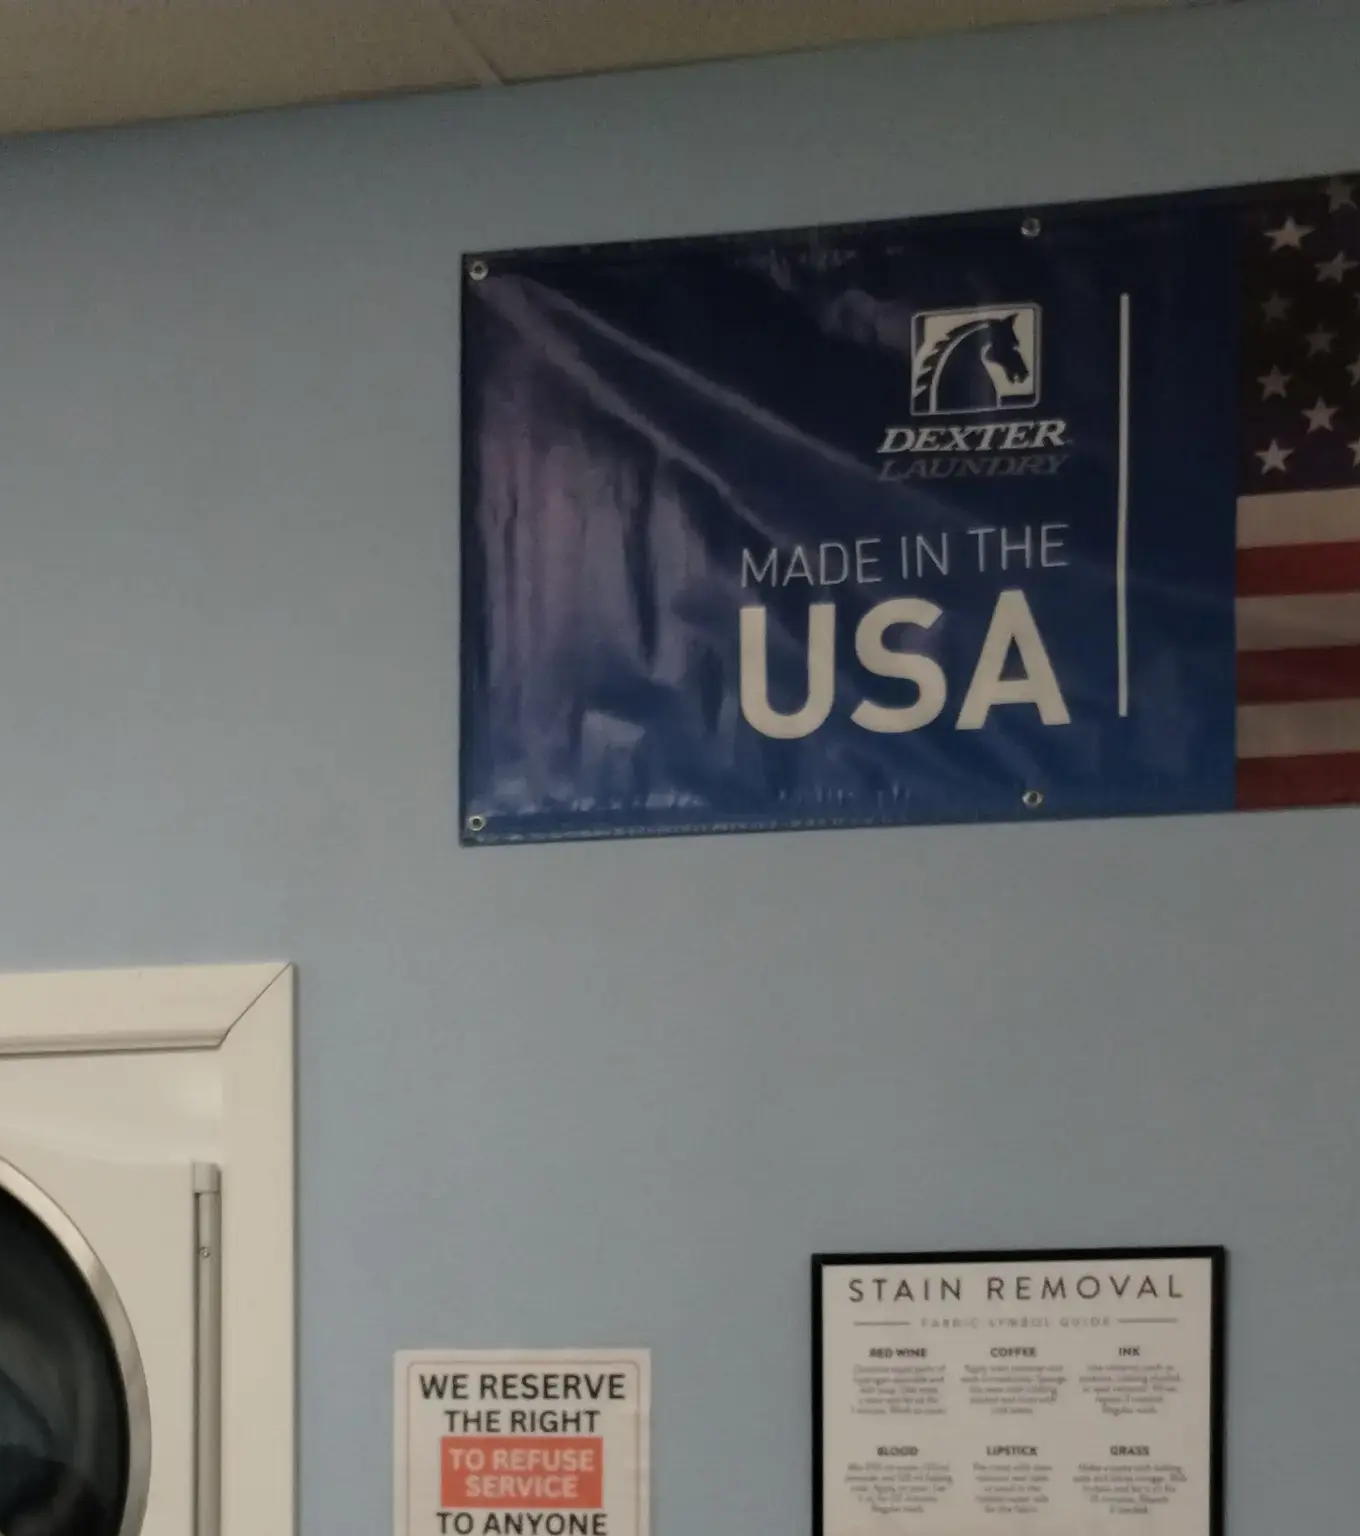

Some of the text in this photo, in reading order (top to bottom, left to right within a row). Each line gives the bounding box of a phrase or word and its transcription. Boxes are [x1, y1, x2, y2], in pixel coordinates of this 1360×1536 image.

[877, 419, 1068, 454] DEXTER
[877, 453, 1071, 482] LAUNDRY
[740, 523, 1070, 589] MADE IN THE
[738, 588, 1072, 740] USA
[848, 1273, 1185, 1303] STAIN REMOVAL
[868, 1346, 928, 1359] RED WINE
[989, 1346, 1037, 1358] COFFEE
[1118, 1346, 1141, 1358] INK
[419, 1373, 627, 1401] WE RESERVE
[444, 1409, 601, 1434] THE RIGHT
[448, 1448, 595, 1471] TO REFUSE
[876, 1444, 920, 1457] BLOOD
[986, 1444, 1038, 1457] LIPSTICK
[1109, 1444, 1150, 1457] GRASS
[464, 1475, 579, 1499] SERVICE
[436, 1512, 609, 1536] TO ANYONE
